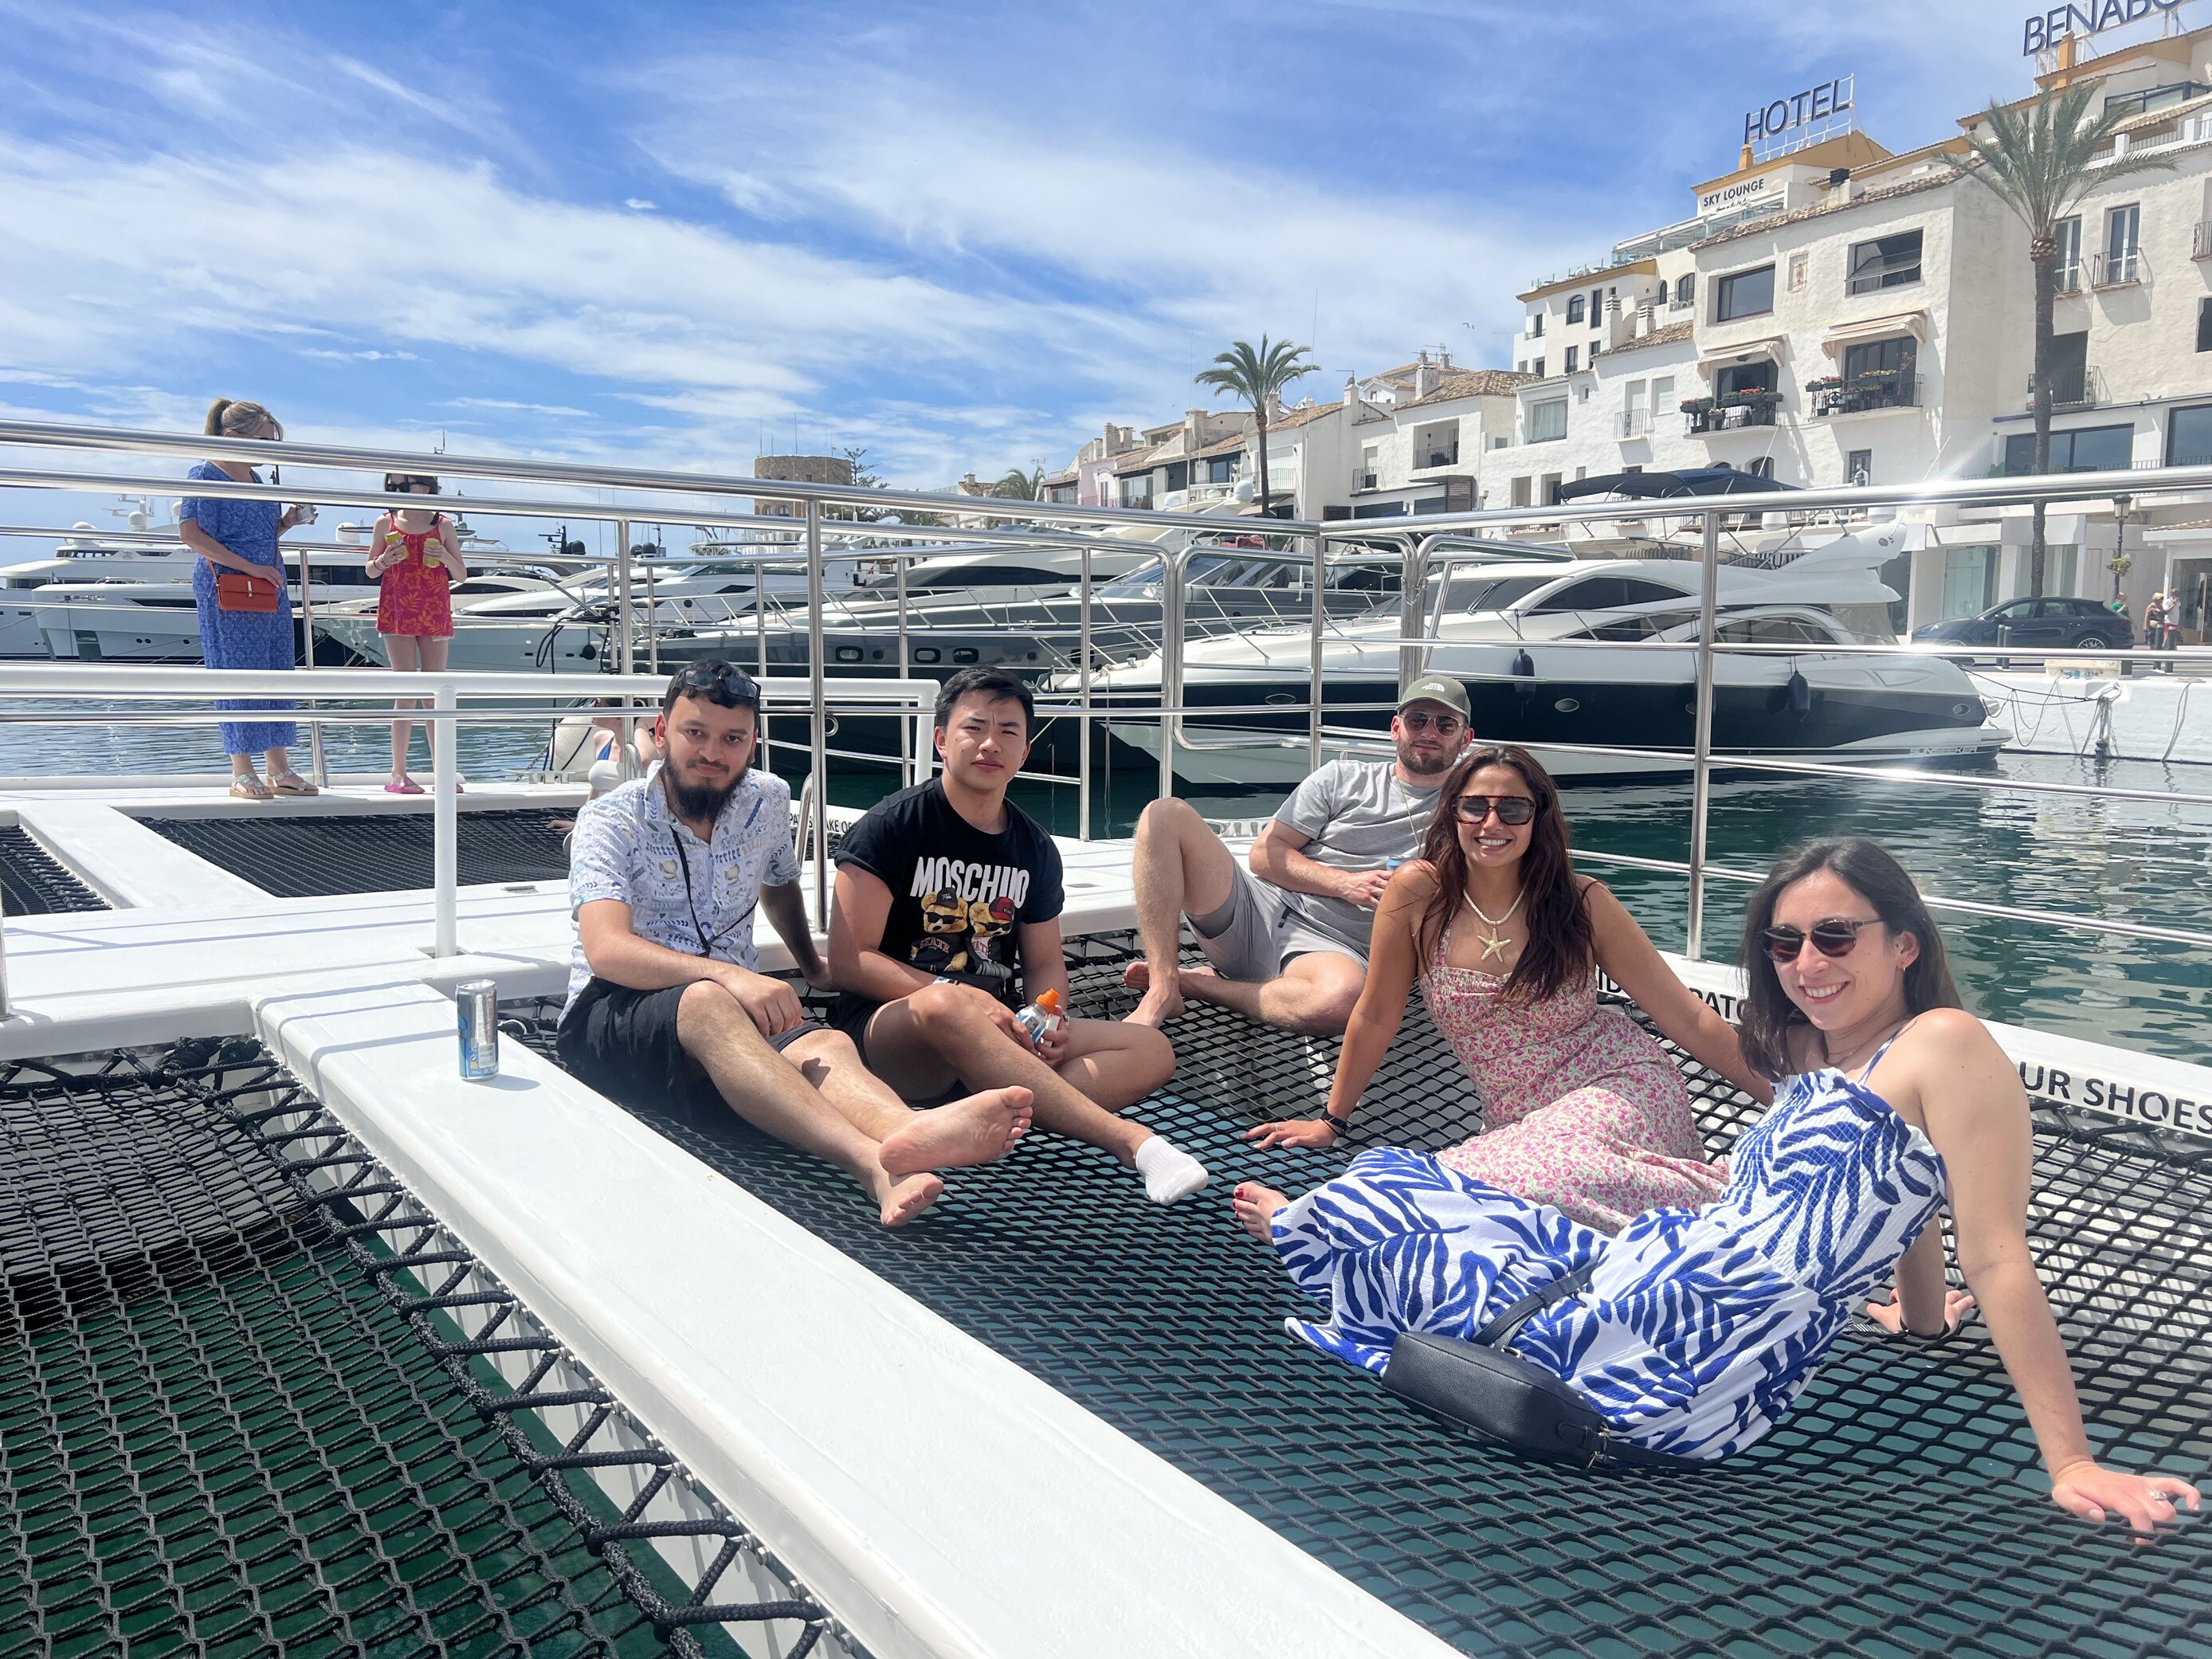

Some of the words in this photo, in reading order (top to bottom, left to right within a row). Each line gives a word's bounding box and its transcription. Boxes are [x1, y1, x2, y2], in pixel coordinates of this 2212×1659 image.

[2023, 0, 2182, 57] BENAB
[1744, 79, 1849, 144] HOTEL
[1704, 193, 1721, 207] SKY
[1724, 178, 1764, 201] LOUNGE
[1910, 746, 1977, 755] SUNSEEKER
[2083, 1078, 2212, 1135] SHOES
